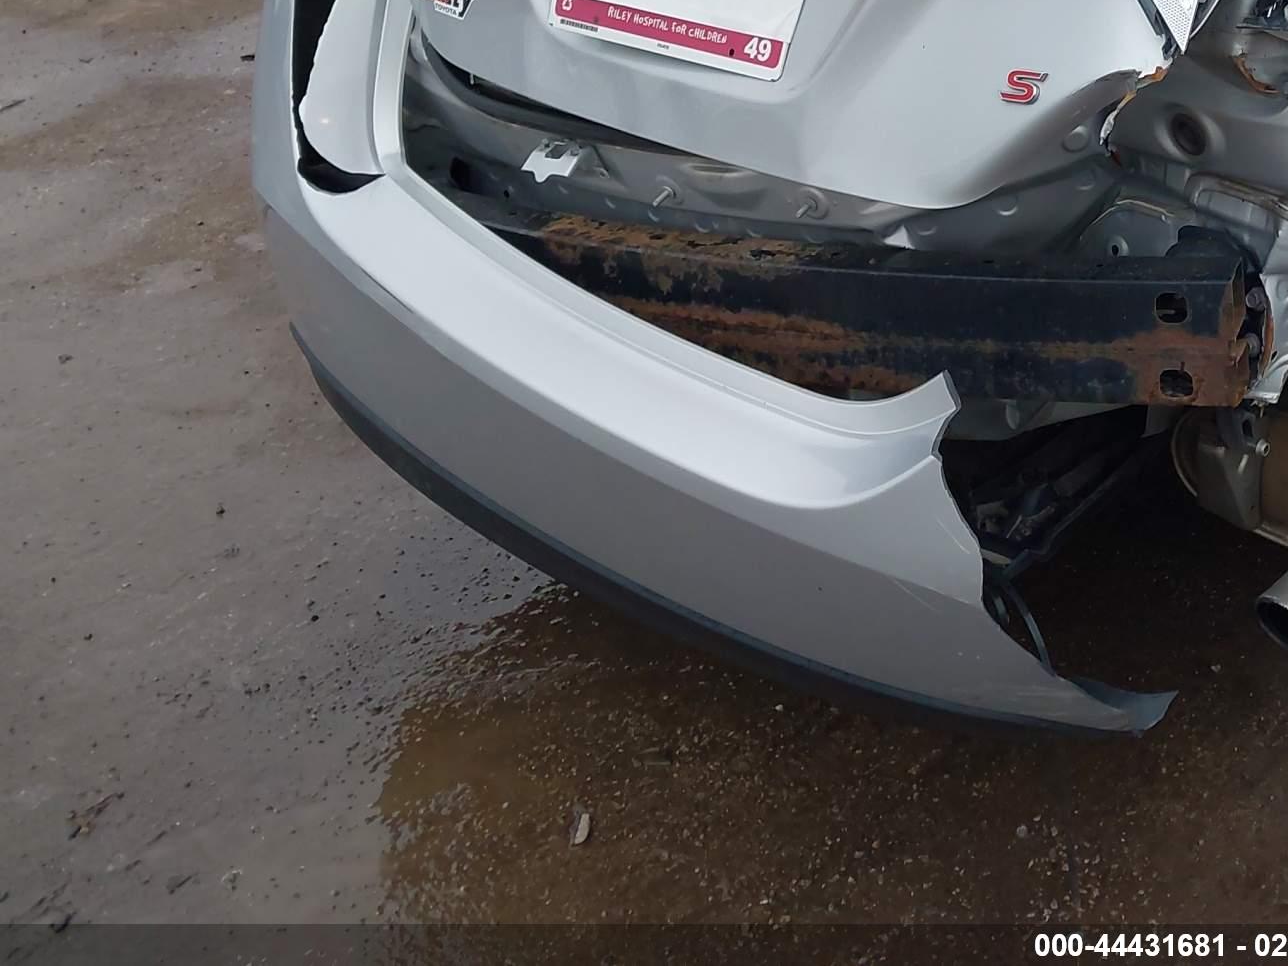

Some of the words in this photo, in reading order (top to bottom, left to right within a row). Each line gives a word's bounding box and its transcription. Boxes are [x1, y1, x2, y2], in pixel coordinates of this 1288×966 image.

[435, 2, 458, 16] TOYOTA
[607, 5, 633, 23] RILEY
[743, 37, 772, 62] 49
[1000, 68, 1048, 105] S
